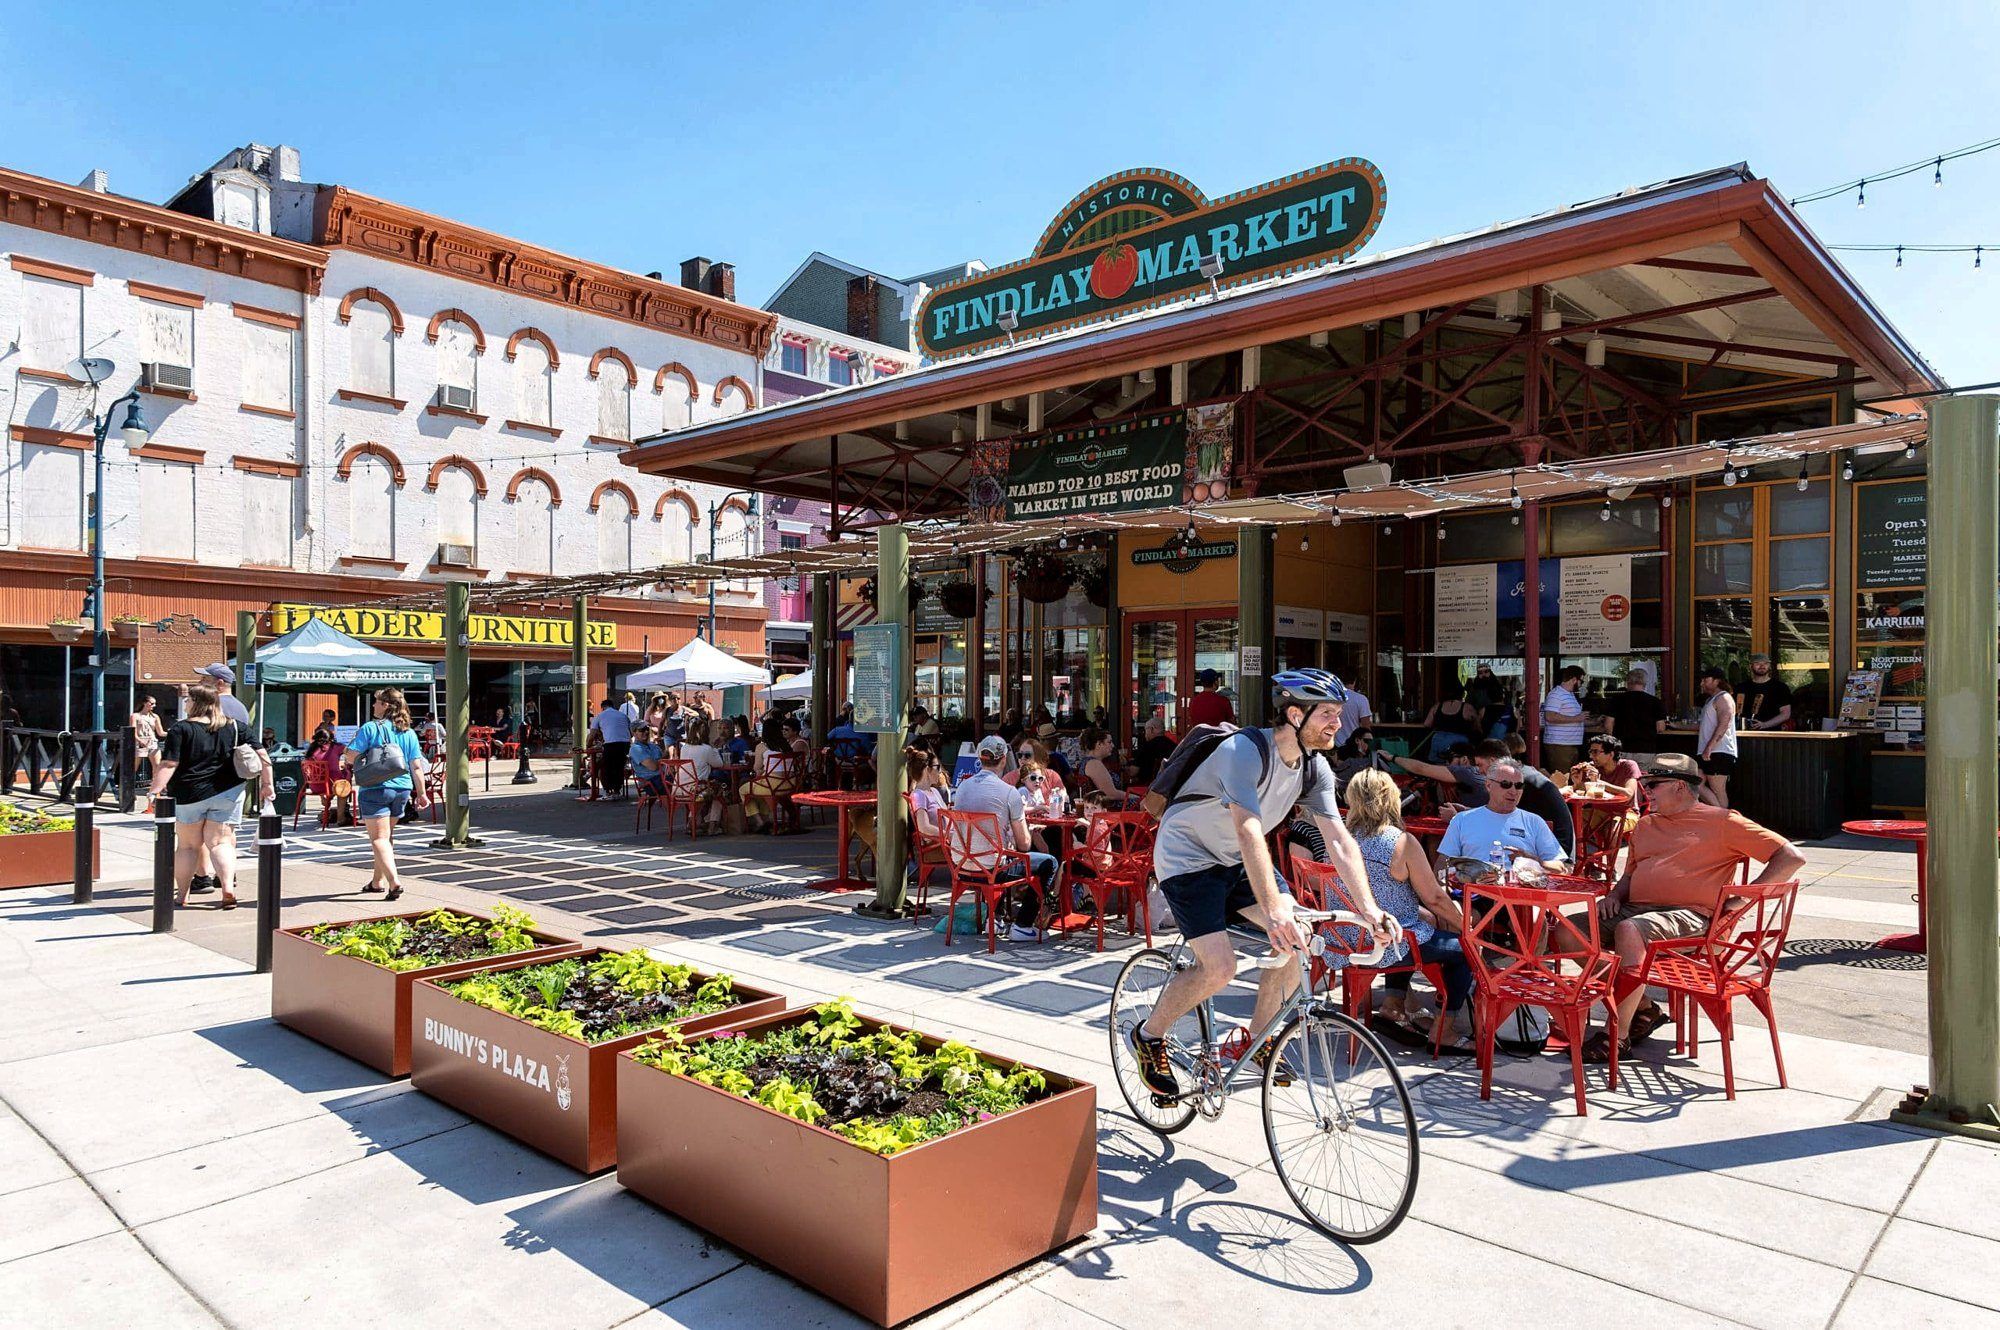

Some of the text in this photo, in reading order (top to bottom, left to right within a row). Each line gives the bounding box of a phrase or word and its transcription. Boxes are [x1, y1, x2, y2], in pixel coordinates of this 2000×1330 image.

[1062, 185, 1173, 238] HISTORIC
[933, 187, 1357, 341] FINDLAY MARKET
[1055, 453, 1088, 464] FINDLAY
[1096, 447, 1128, 459] MARKET
[1007, 463, 1181, 498] NAMED TOP 10 BEST FOOD
[1014, 484, 1173, 515] MARKET IN THE WORLD
[1885, 520, 1918, 531] Open
[1134, 545, 1235, 561] FINDLAY MARKET
[1865, 616, 1925, 629] KARRIKIN
[285, 671, 414, 681] FINDLAY MARKET
[425, 1017, 551, 1093] BUNNY'S PLAZA
